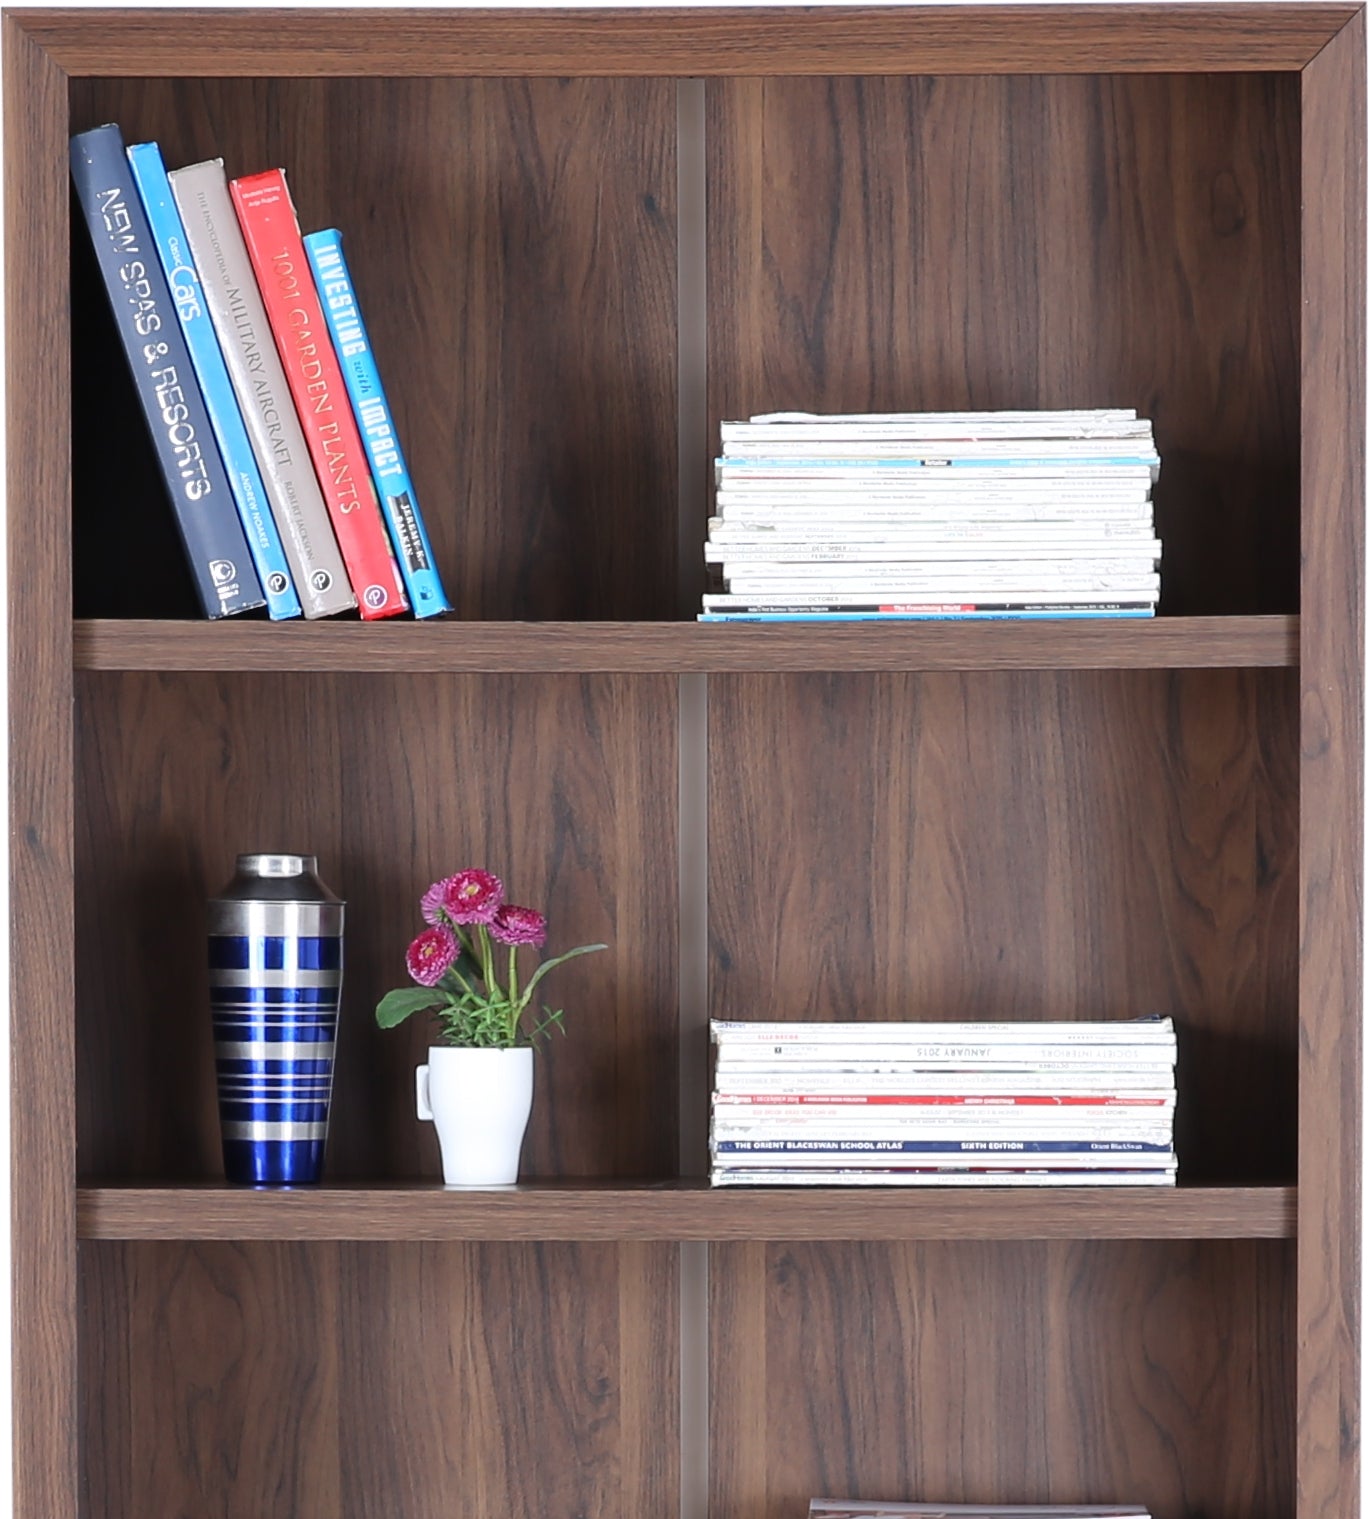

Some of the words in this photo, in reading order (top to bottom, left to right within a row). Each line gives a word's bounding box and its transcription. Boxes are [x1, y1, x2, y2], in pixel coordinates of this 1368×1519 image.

[97, 188, 139, 253] NEW
[120, 261, 162, 336] SPAS
[170, 265, 202, 322] Cars
[314, 243, 367, 357] INVESTING
[143, 342, 169, 365] &
[226, 287, 266, 377] MILITARY
[253, 378, 294, 467] AIRCRAFT
[271, 251, 301, 300] 1001
[288, 307, 334, 414] GARDEN
[319, 421, 361, 514] PLANTS
[353, 360, 372, 394] with
[151, 366, 212, 501] RESORTS
[358, 396, 403, 478] IMPACT
[240, 471, 259, 512] ANDREW
[252, 511, 271, 549] NOAKES
[400, 503, 421, 550] JEREMY
[916, 1047, 941, 1057] 2015
[945, 1048, 991, 1057] JANUARY
